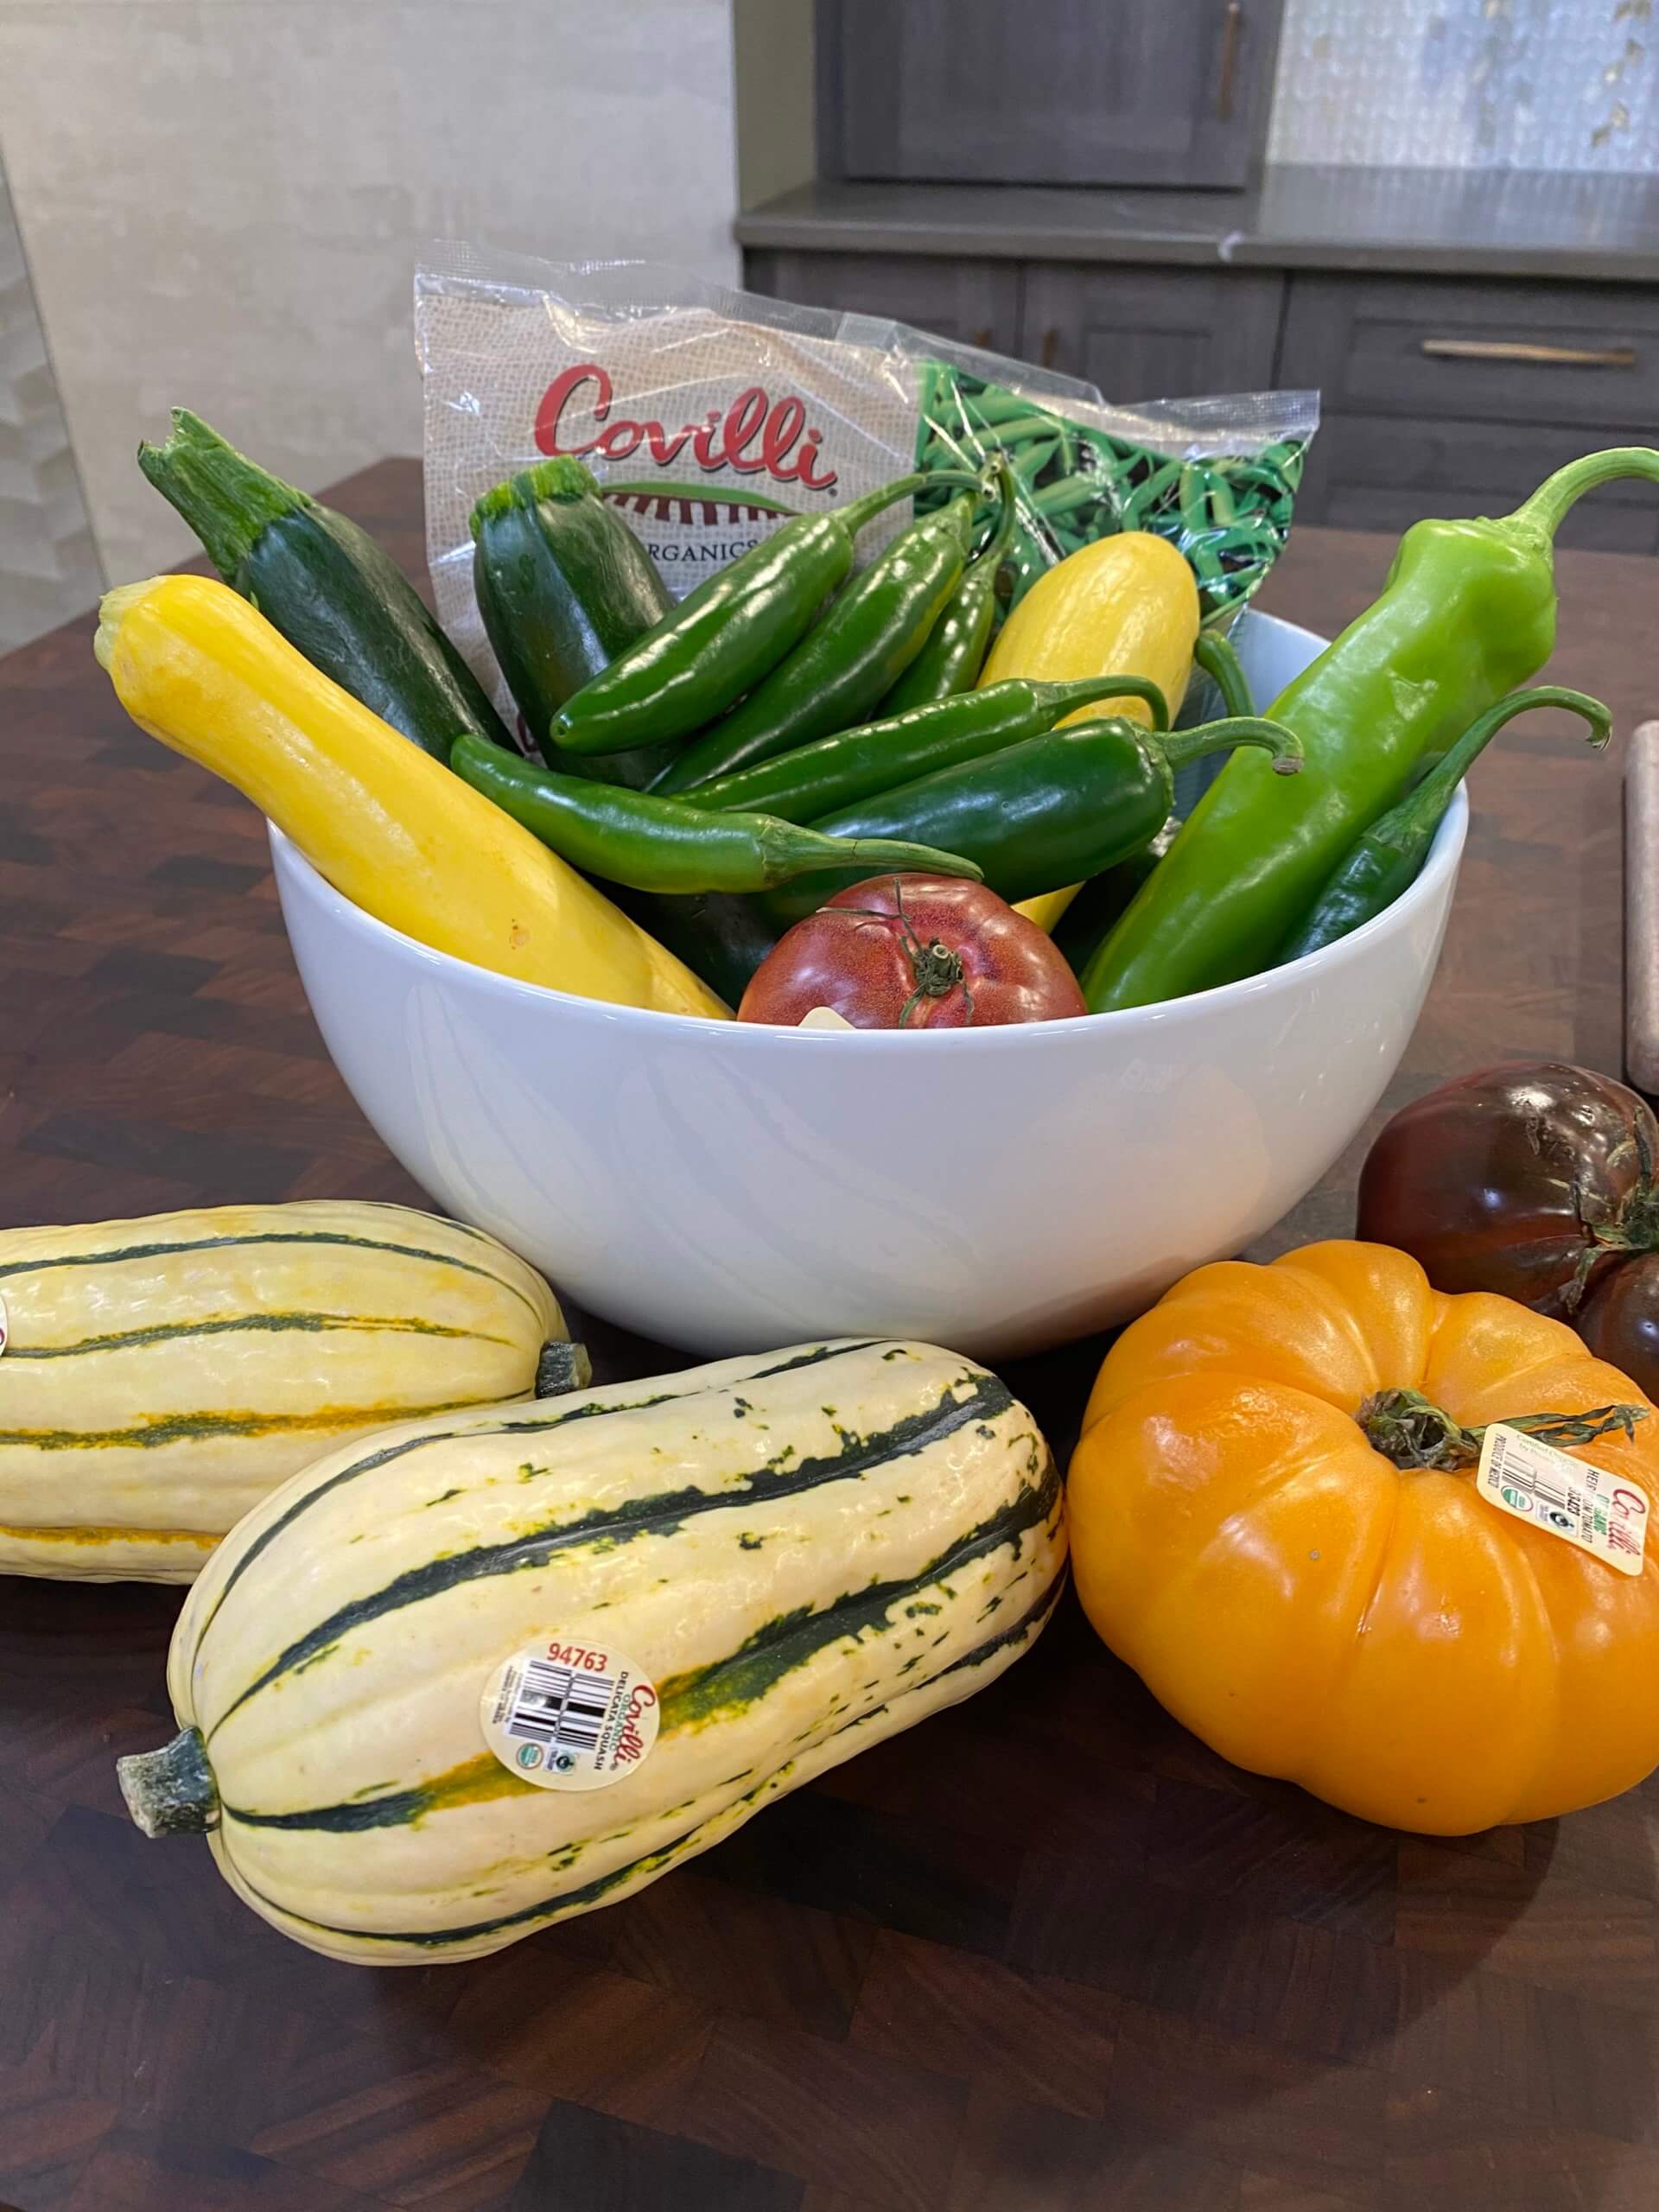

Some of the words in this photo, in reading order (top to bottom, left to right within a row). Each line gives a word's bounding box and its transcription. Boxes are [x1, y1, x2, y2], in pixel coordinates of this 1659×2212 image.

[534, 363, 837, 489] Covilli
[645, 538, 759, 563] RGANIC
[1581, 1468, 1599, 1515] HEIROM
[547, 1643, 608, 1672] 94763
[608, 1671, 629, 1725] DELICATA
[609, 1694, 631, 1751] ORGANIC
[594, 1725, 610, 1770] SQUASH
[618, 1685, 656, 1764] Covilli
